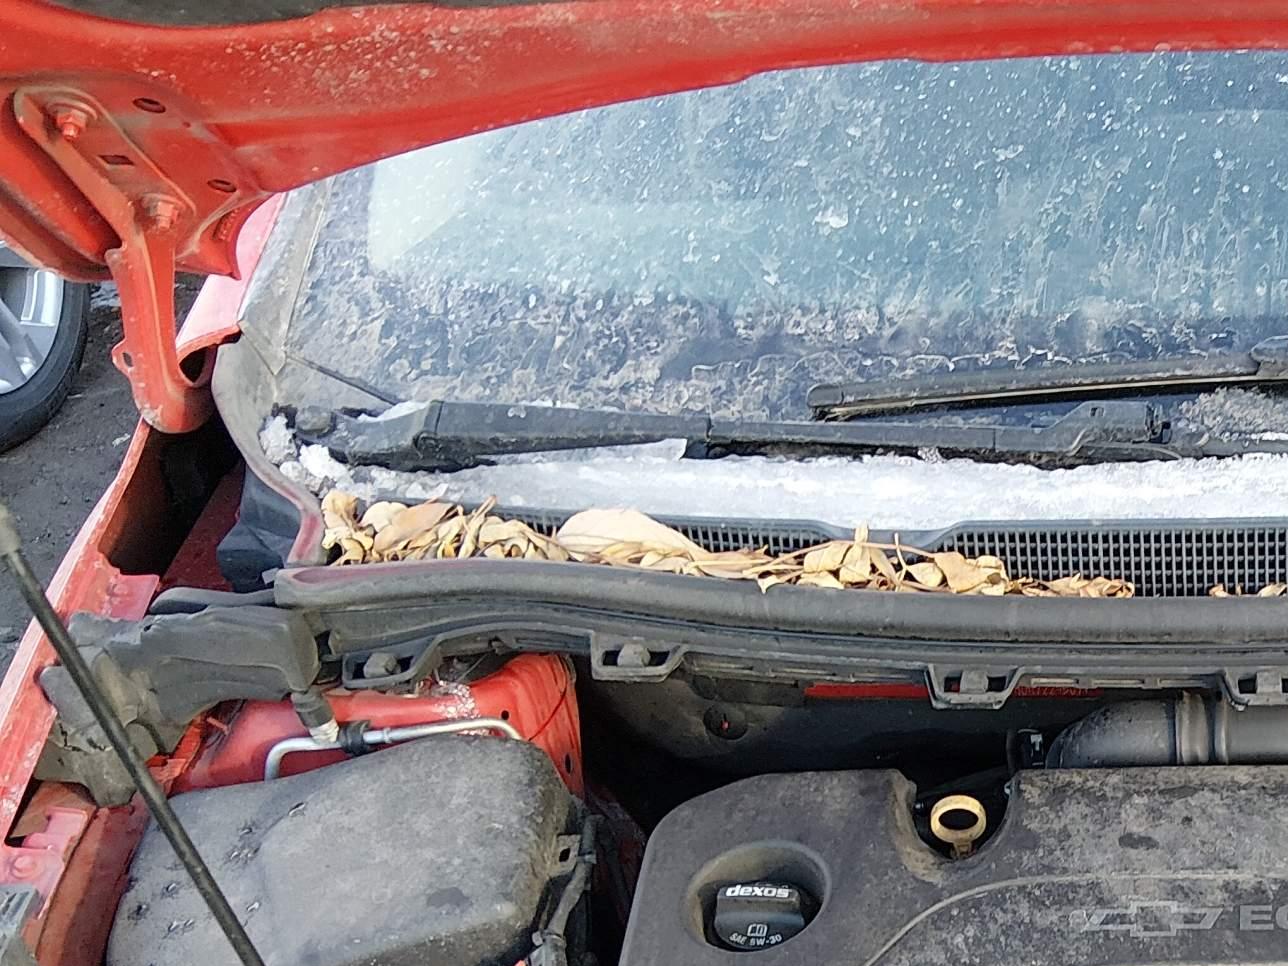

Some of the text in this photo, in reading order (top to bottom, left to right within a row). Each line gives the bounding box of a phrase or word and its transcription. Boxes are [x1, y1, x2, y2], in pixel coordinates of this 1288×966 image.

[725, 885, 792, 898] dexos
[729, 933, 782, 946] SAE 5W-30
